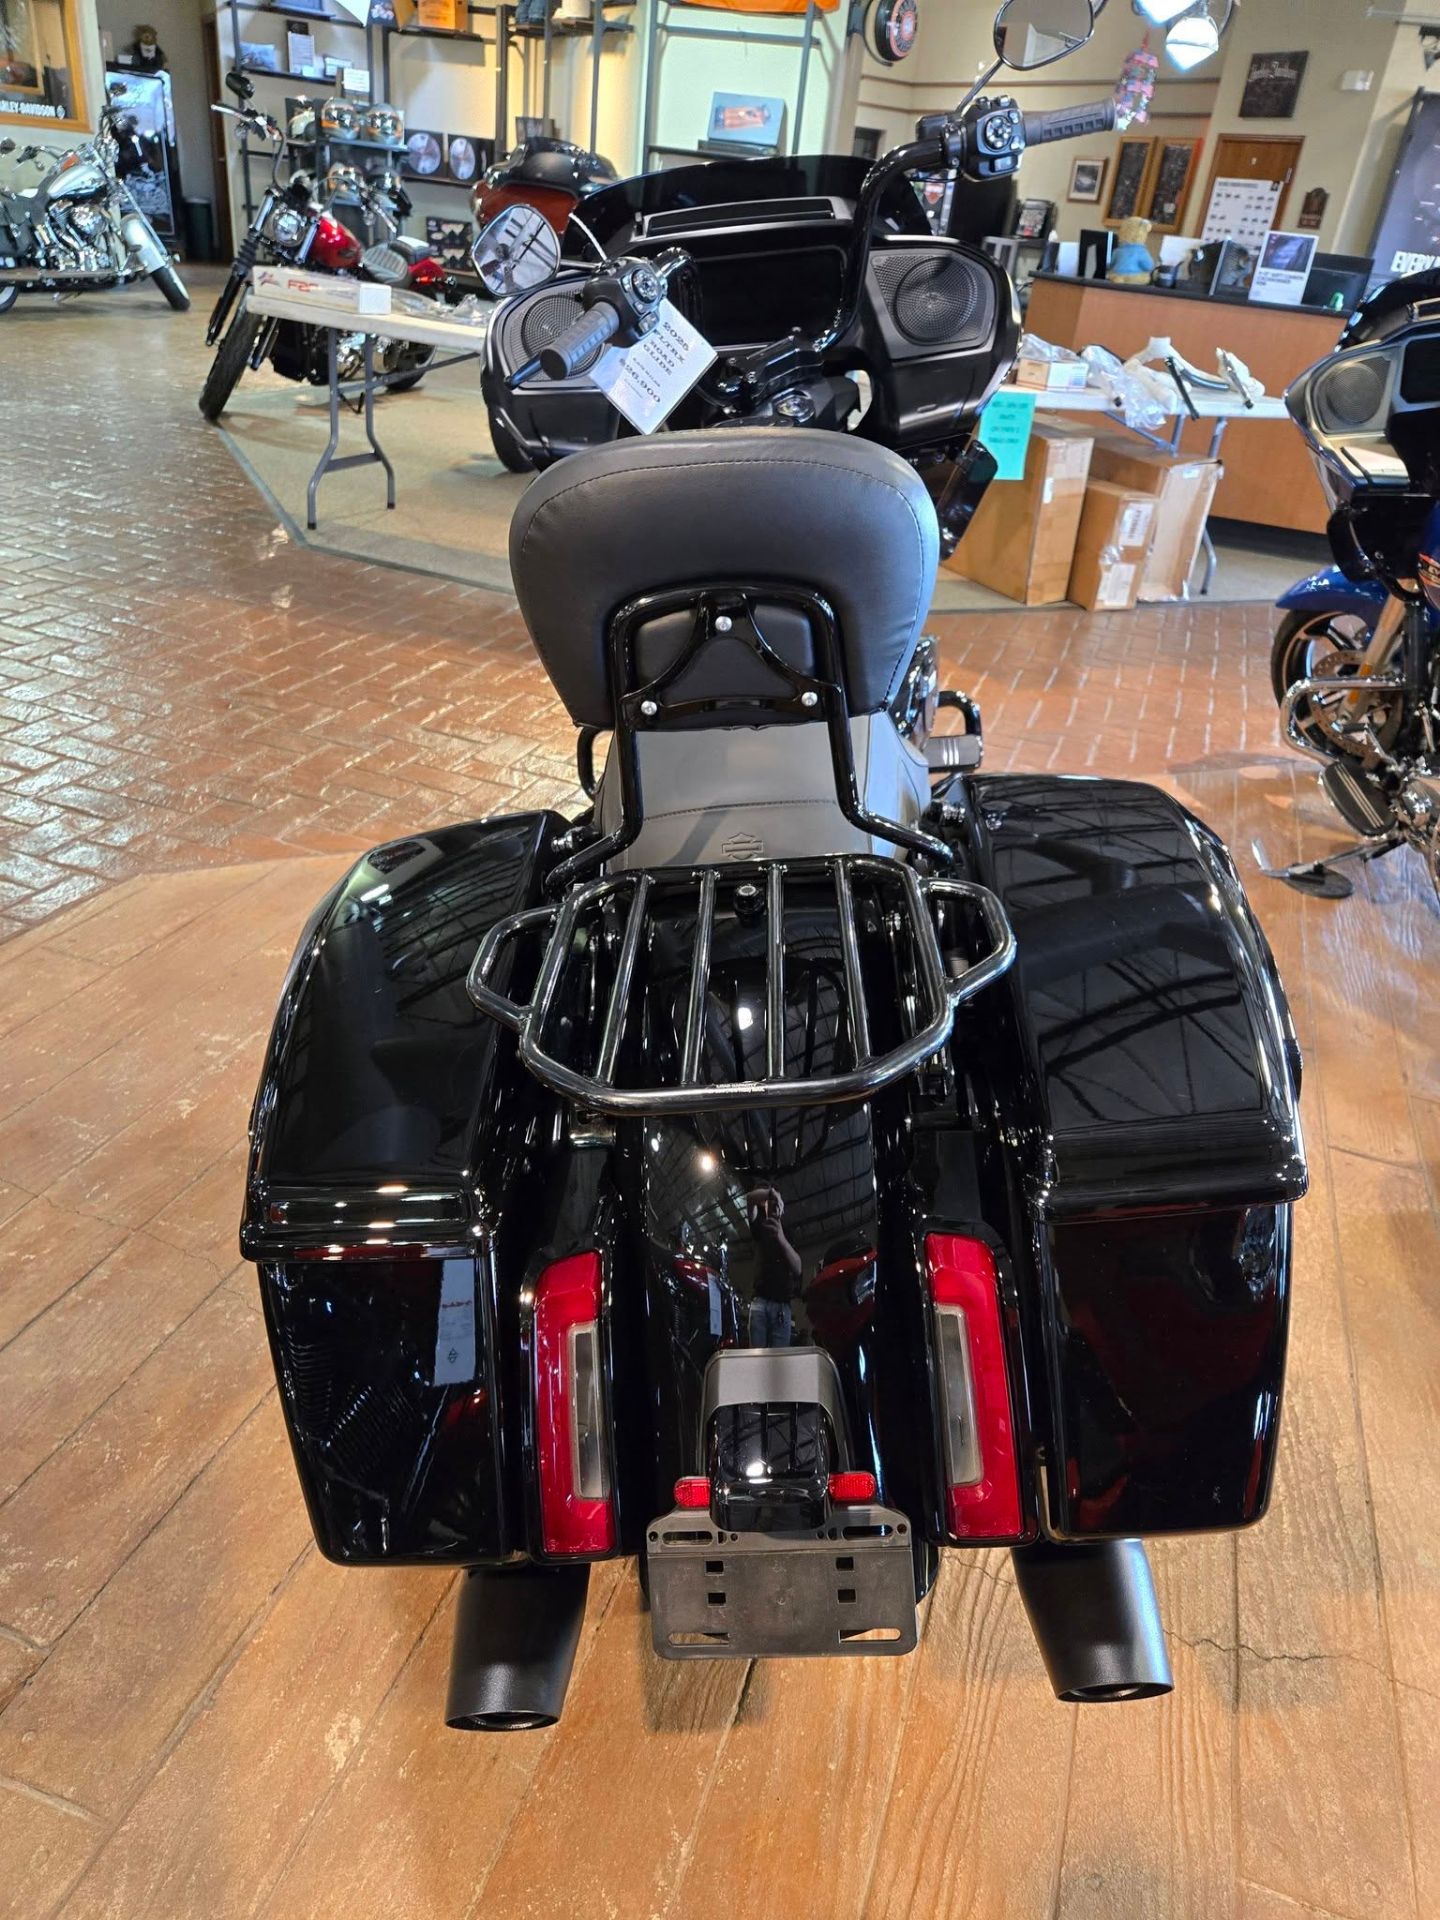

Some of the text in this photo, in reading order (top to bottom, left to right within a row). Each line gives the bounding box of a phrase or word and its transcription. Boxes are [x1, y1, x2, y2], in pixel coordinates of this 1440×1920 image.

[663, 322, 689, 351] 2025
[643, 344, 672, 376] GLIDE
[650, 340, 675, 367] ROAD
